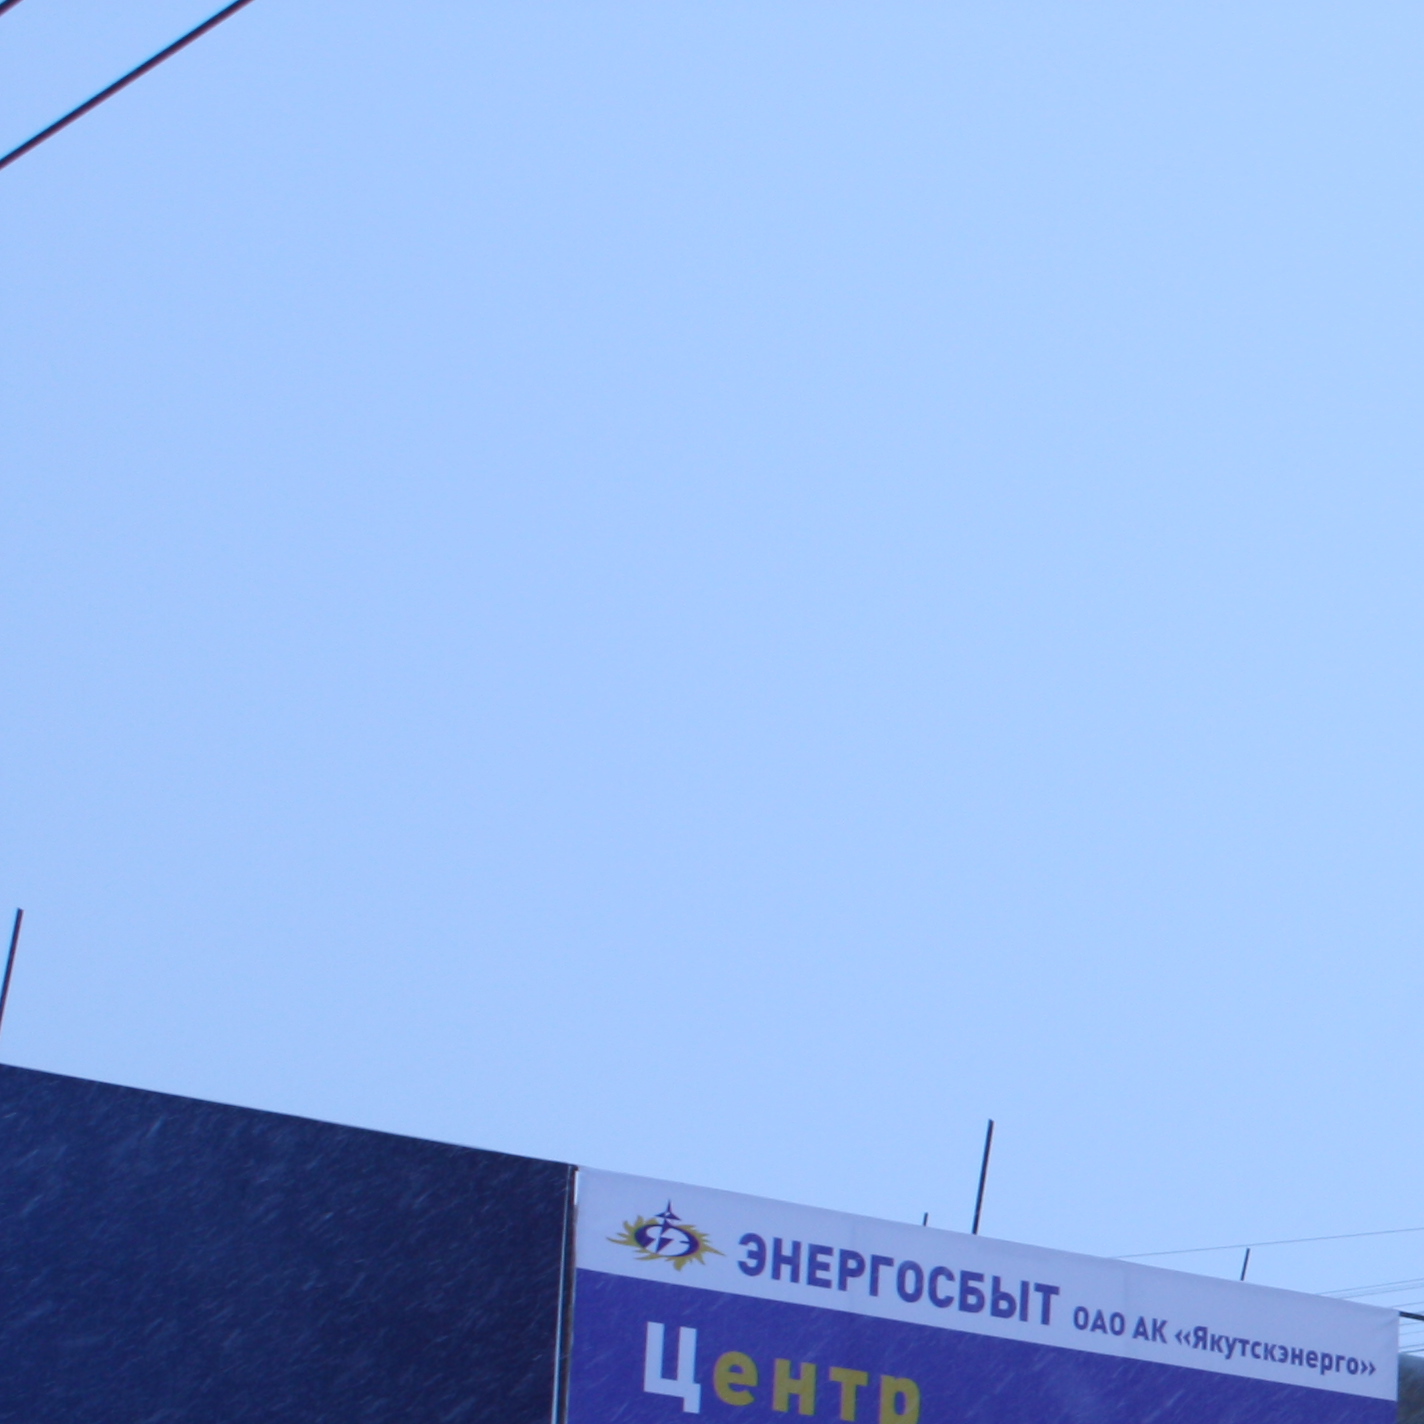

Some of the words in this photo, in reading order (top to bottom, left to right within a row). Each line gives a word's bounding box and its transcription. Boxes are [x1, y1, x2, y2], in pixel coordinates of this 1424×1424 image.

[737, 1232, 1060, 1327] ЭНЕРГОСБЫТ
[1073, 1305, 1125, 1336] ОАО
[1133, 1316, 1168, 1344] АК
[1174, 1326, 1377, 1377] «Якутскэнерго»
